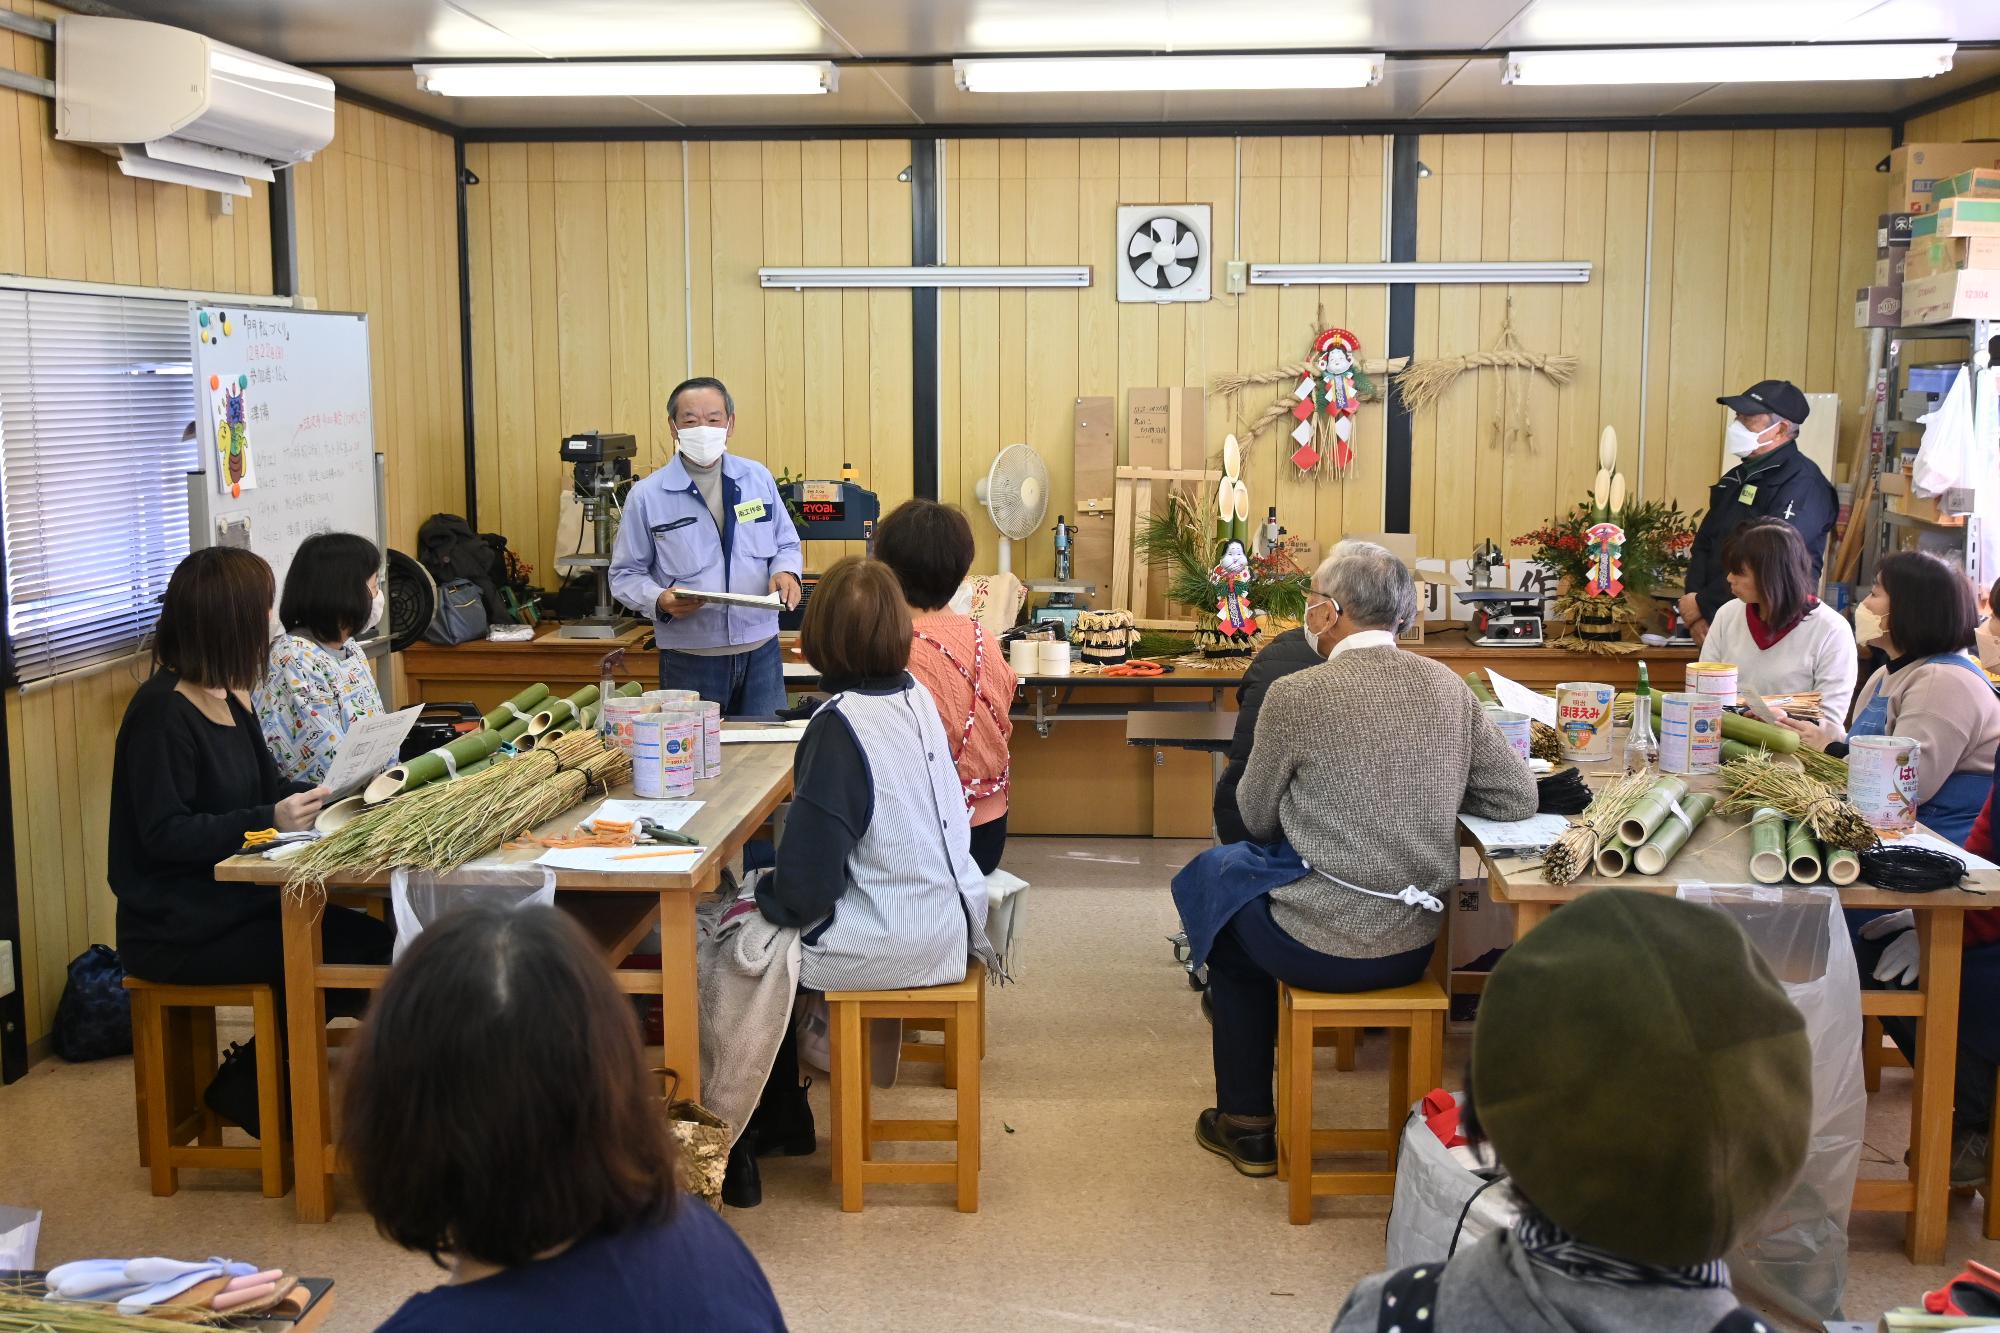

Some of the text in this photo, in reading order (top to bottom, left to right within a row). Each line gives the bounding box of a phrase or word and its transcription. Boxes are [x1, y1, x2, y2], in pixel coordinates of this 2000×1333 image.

[803, 503, 833, 513] RYOBI
[1560, 705, 1600, 719] ほほえみ
